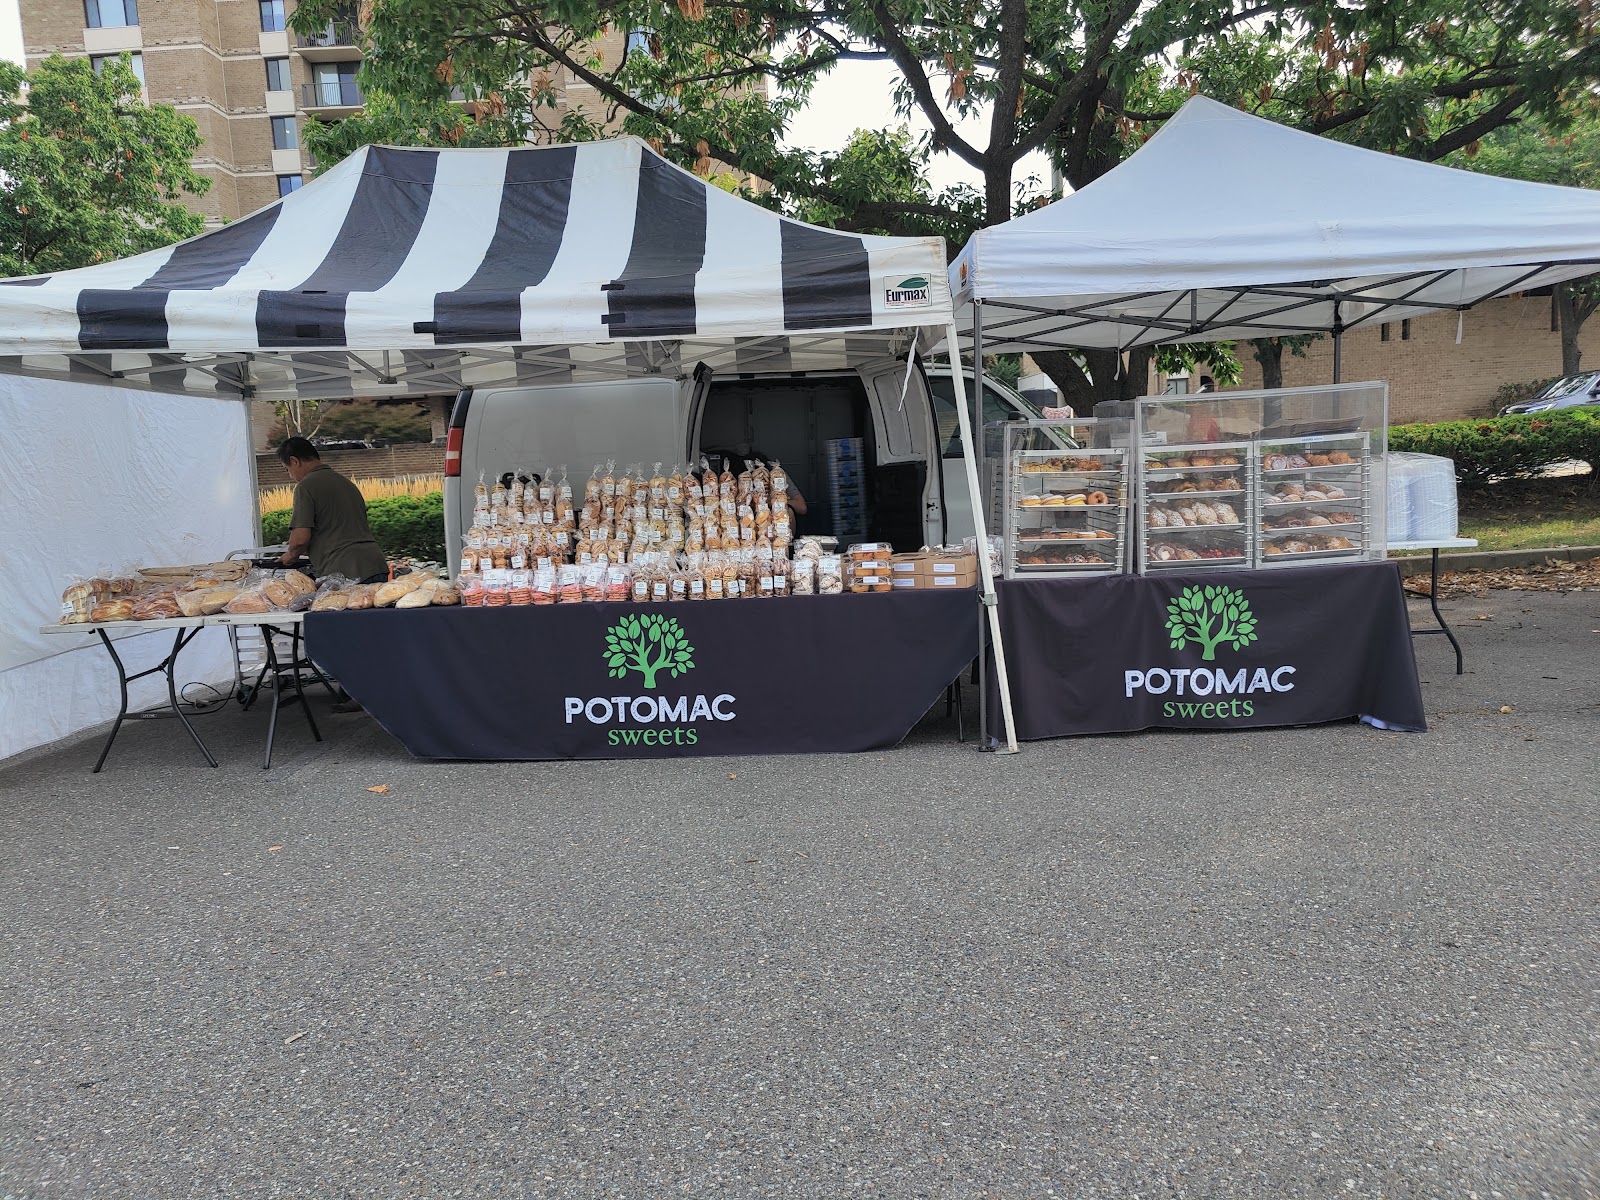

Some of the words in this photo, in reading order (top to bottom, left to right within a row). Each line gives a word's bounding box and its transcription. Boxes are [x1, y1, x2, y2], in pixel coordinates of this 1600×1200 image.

[886, 289, 927, 302] Eurmax
[1125, 665, 1296, 697] POTOMAC
[564, 694, 737, 724] POTOMAC
[1163, 698, 1254, 719] sweets
[608, 726, 698, 746] sweets
